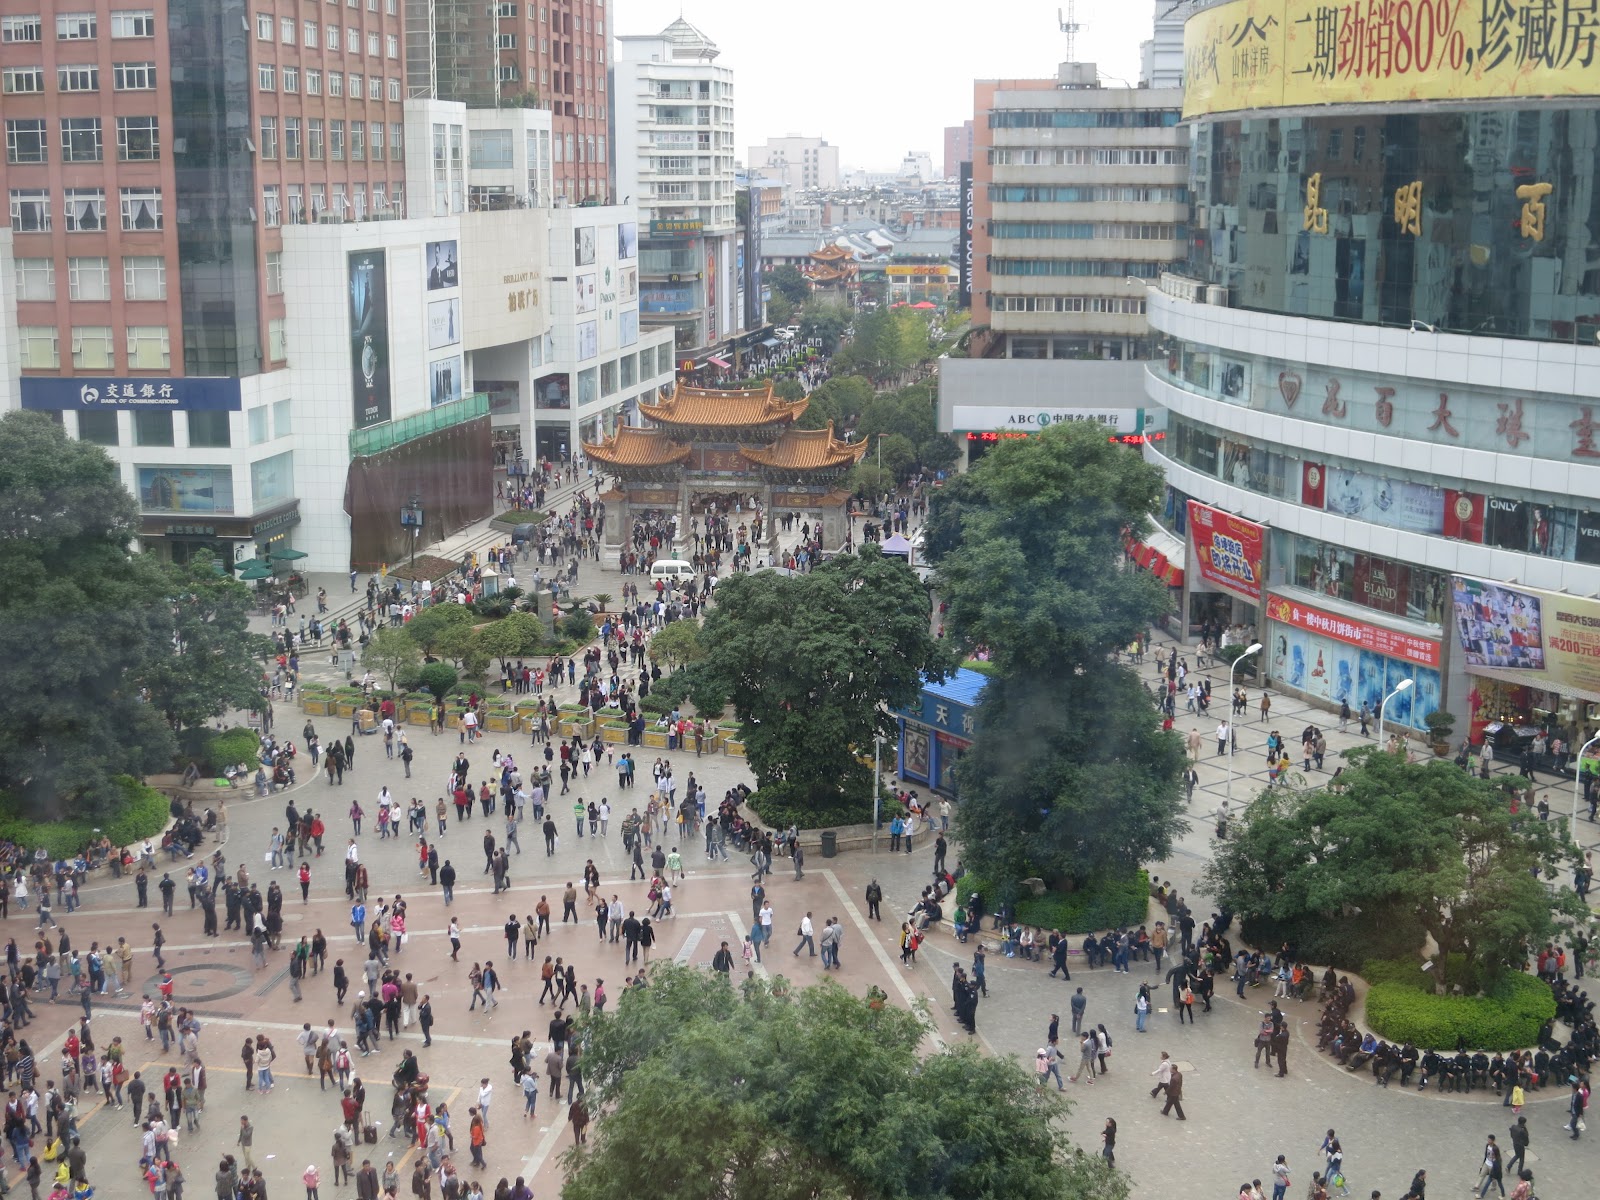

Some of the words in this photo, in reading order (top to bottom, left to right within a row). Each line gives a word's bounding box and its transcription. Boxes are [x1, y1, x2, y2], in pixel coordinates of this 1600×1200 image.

[1231, 46, 1269, 78] 山林洋房
[1008, 414, 1035, 424] ABC
[1490, 500, 1518, 512] ONLY
[254, 516, 283, 533] STARBUCKS
[1211, 549, 1254, 581] 即将开业
[1407, 638, 1432, 651] 中秋佳节
